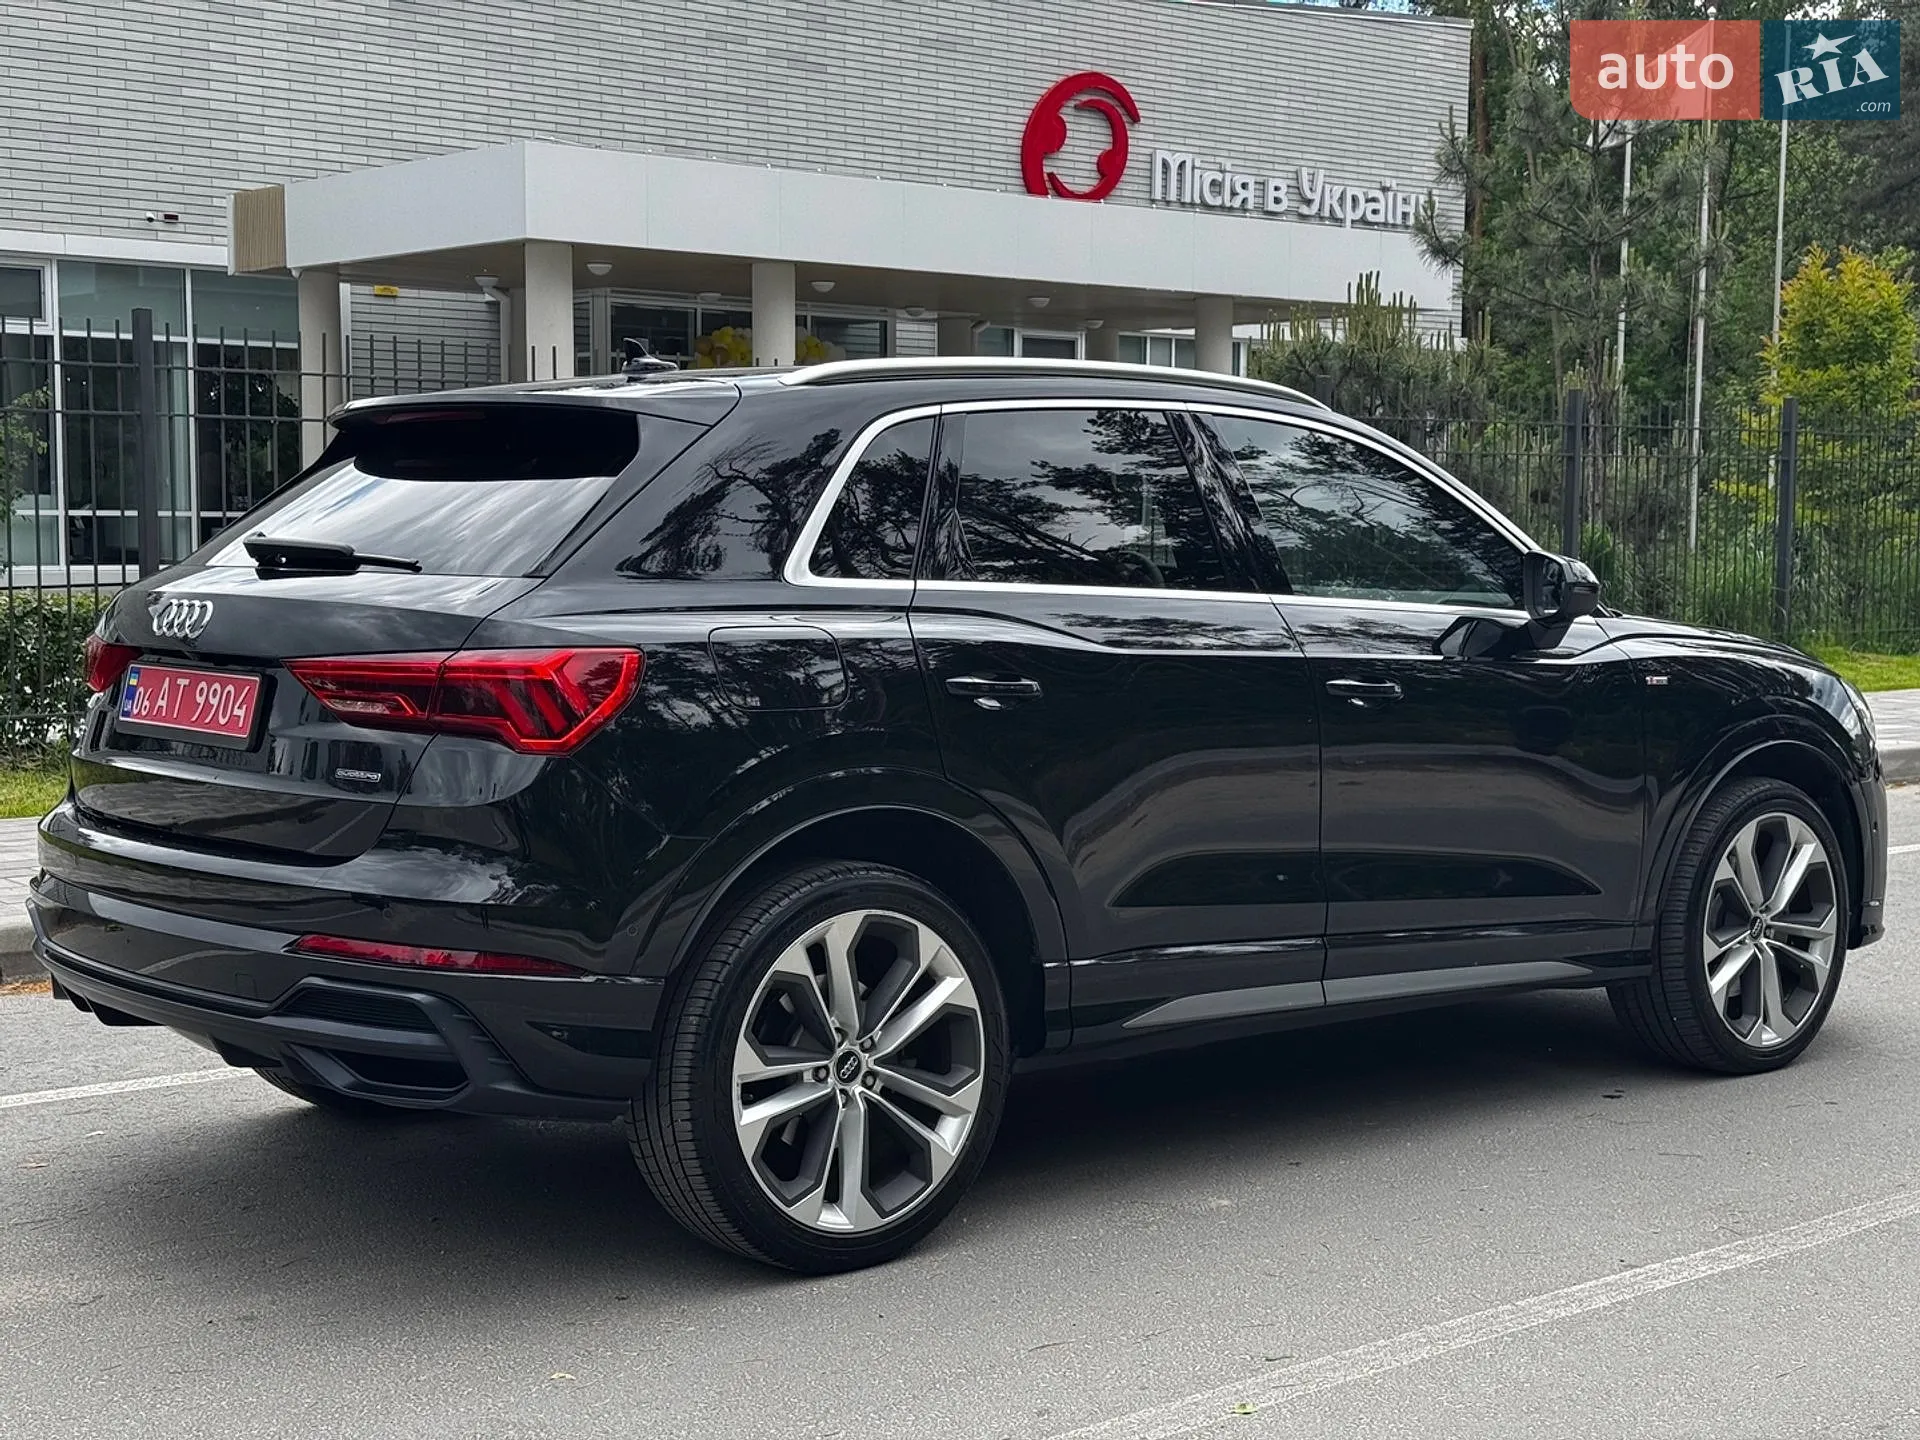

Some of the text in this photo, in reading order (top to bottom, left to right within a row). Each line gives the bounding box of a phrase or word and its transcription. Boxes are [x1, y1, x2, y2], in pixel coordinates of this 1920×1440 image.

[1151, 149, 1255, 210] Місія
[1263, 176, 1290, 213] в
[132, 676, 250, 729] 06 AT 9904
